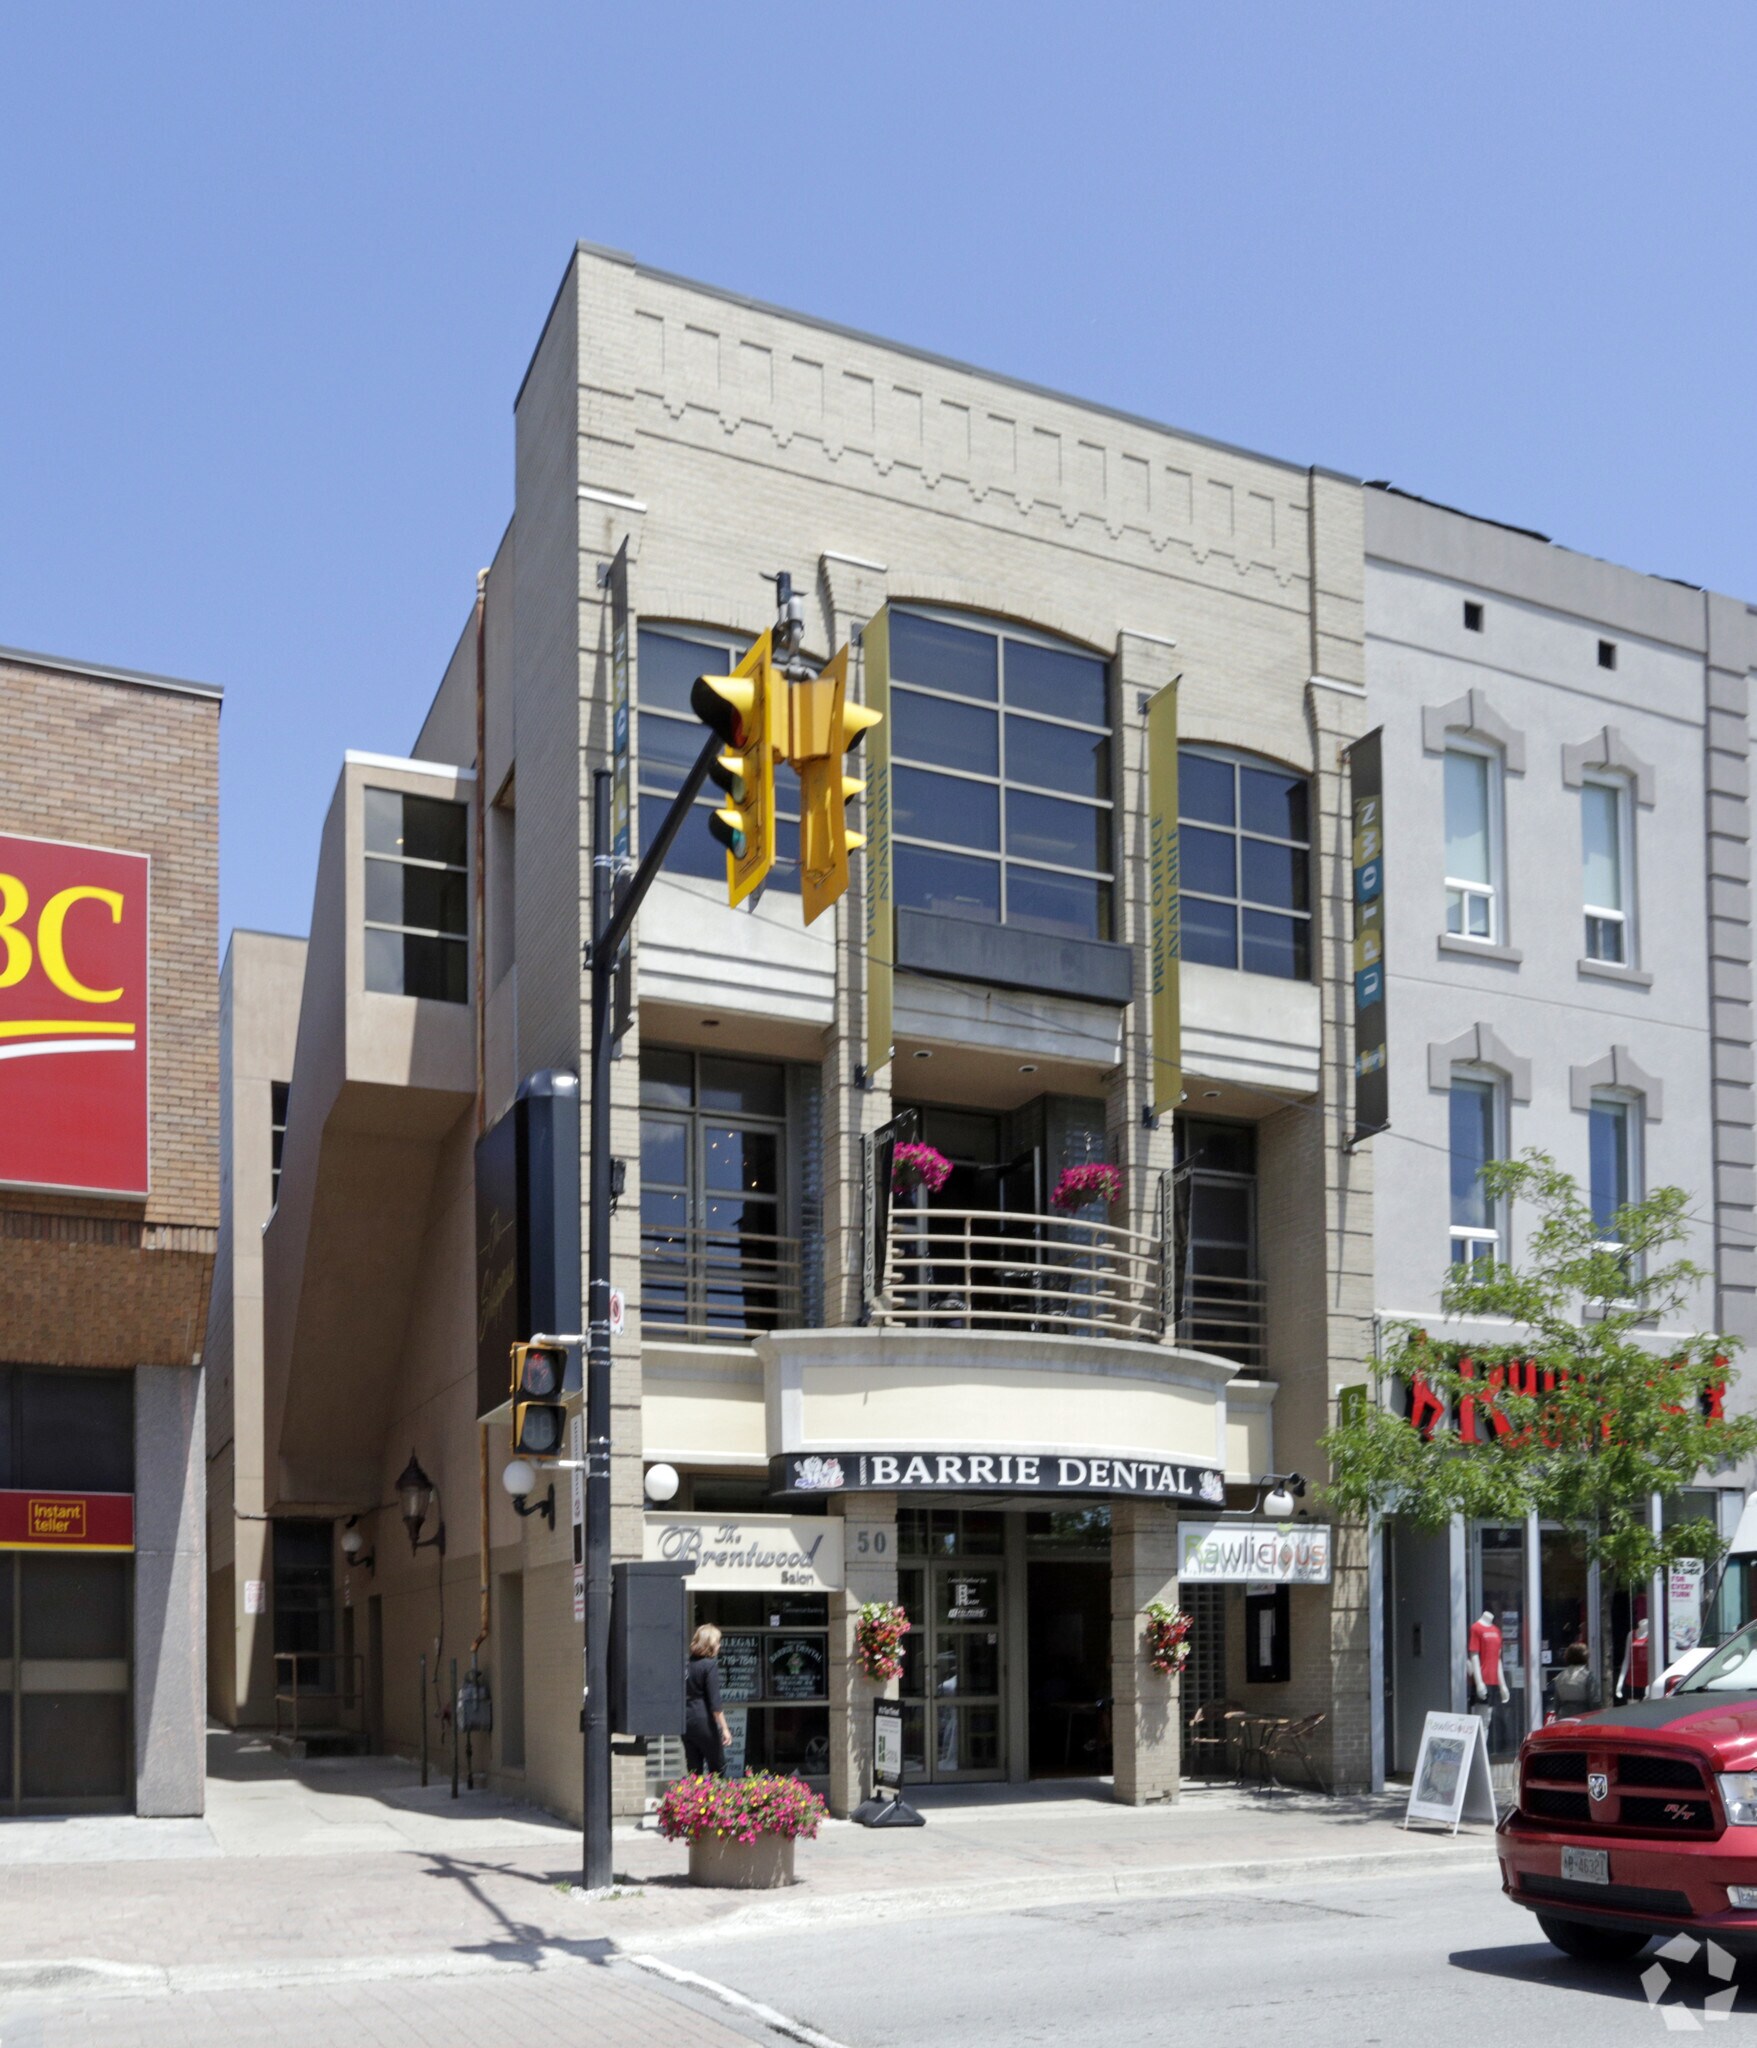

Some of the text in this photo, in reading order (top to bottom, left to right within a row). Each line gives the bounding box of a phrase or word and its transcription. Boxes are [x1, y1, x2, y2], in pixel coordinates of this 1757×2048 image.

[866, 761, 876, 938] PRIME RETAIL
[877, 765, 889, 900] AVAILABLE
[1151, 815, 1164, 995] PRIME OFFICE
[1167, 827, 1180, 959] AVAILABLE
[1361, 801, 1378, 997] UPTOWN
[871, 1455, 1193, 1496] BARRIE DENTAL
[34, 1503, 81, 1519] Instant
[34, 1517, 70, 1532] teller
[657, 1525, 824, 1571] Brentwood
[714, 1522, 742, 1545] The
[857, 1530, 887, 1554] 50
[1184, 1531, 1328, 1573] Rawlicious
[781, 1570, 815, 1586] Salon
[1664, 1803, 1696, 1821] R/T
